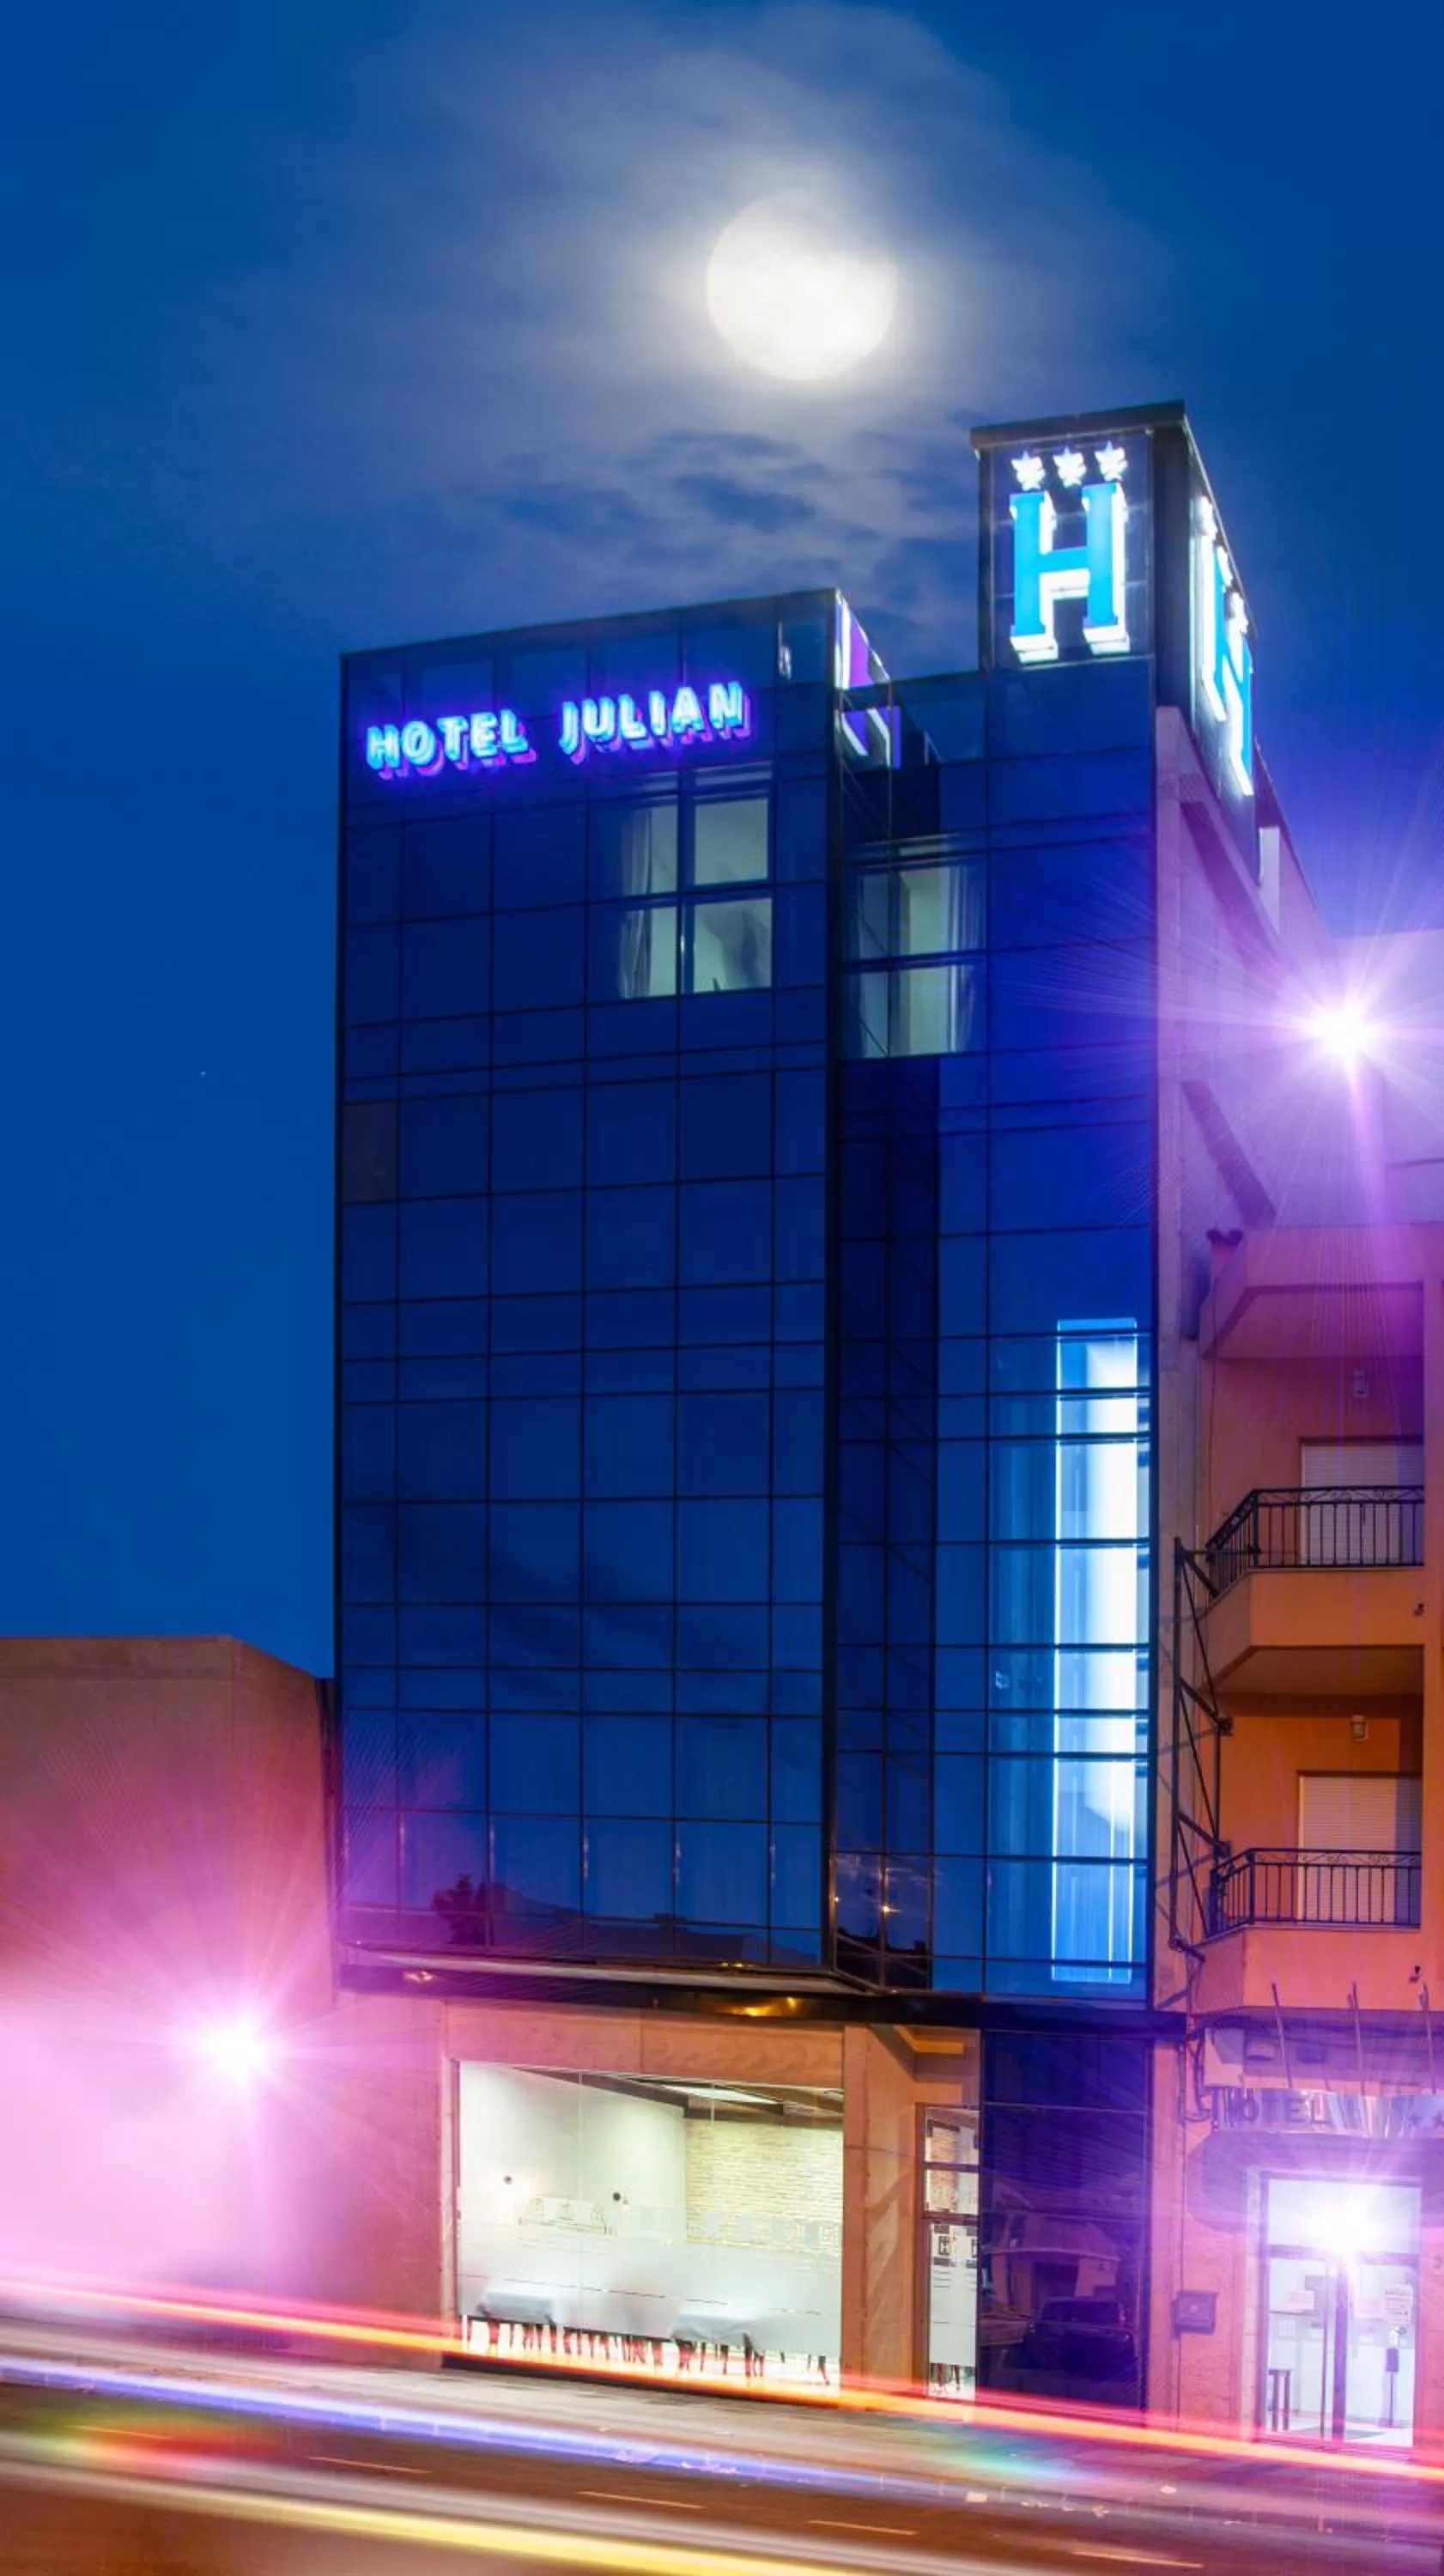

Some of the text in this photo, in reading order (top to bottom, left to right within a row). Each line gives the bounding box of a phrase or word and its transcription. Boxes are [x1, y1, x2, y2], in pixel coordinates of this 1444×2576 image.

[1010, 483, 1130, 663] H
[367, 681, 746, 772] HOTEL JULIAN
